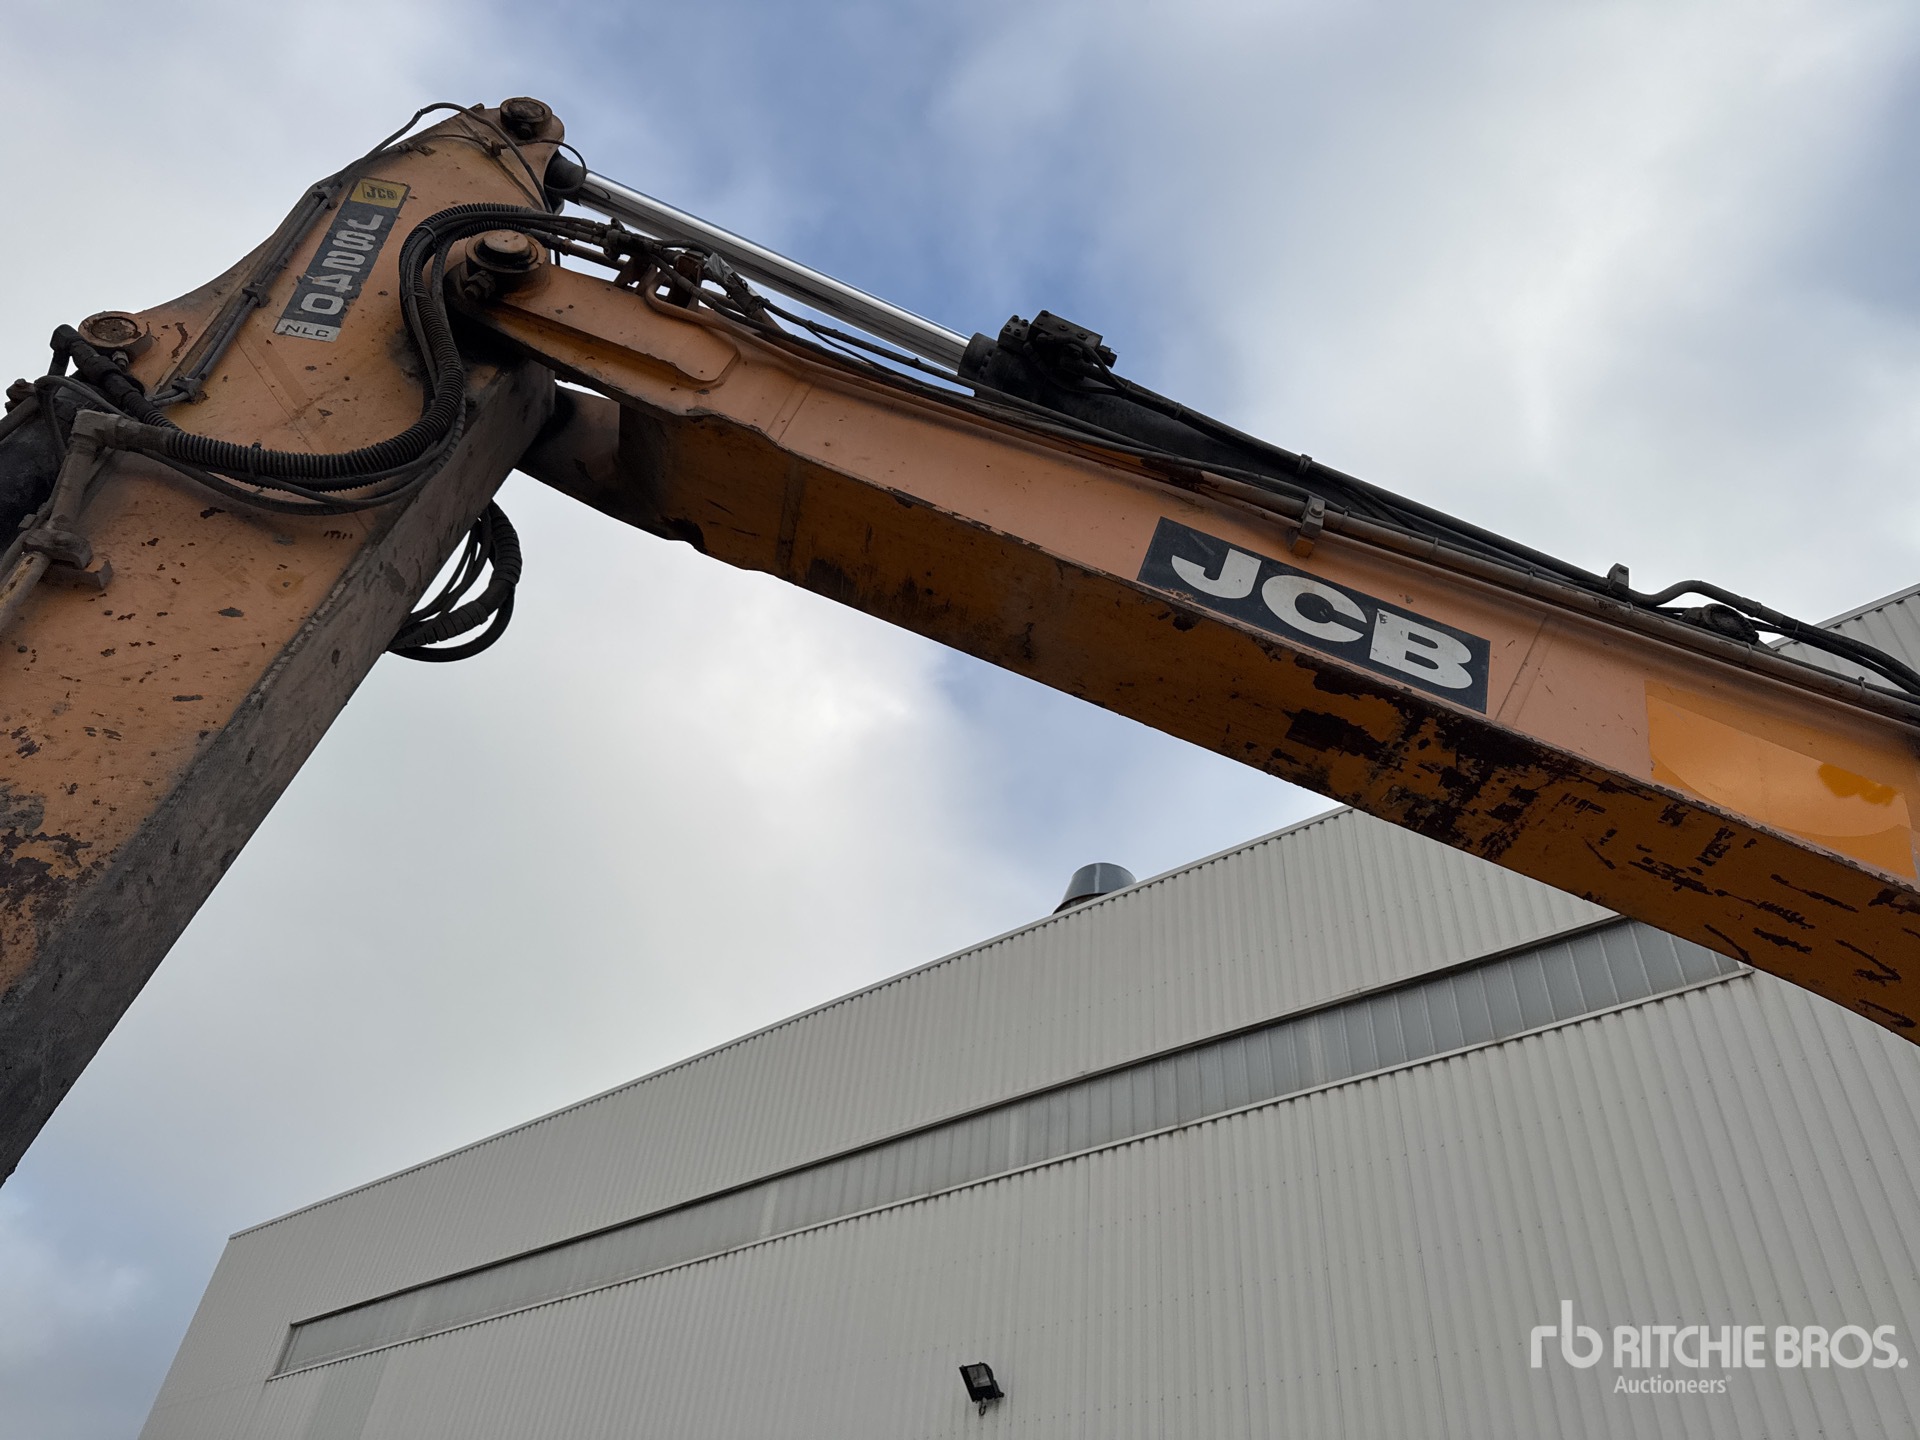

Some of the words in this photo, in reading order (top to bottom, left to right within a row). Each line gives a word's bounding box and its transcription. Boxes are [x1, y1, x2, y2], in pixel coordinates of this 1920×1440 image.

[366, 186, 396, 199] JCB
[301, 214, 384, 315] JS240
[285, 324, 329, 338] NLC
[1171, 548, 1473, 689] JCB
